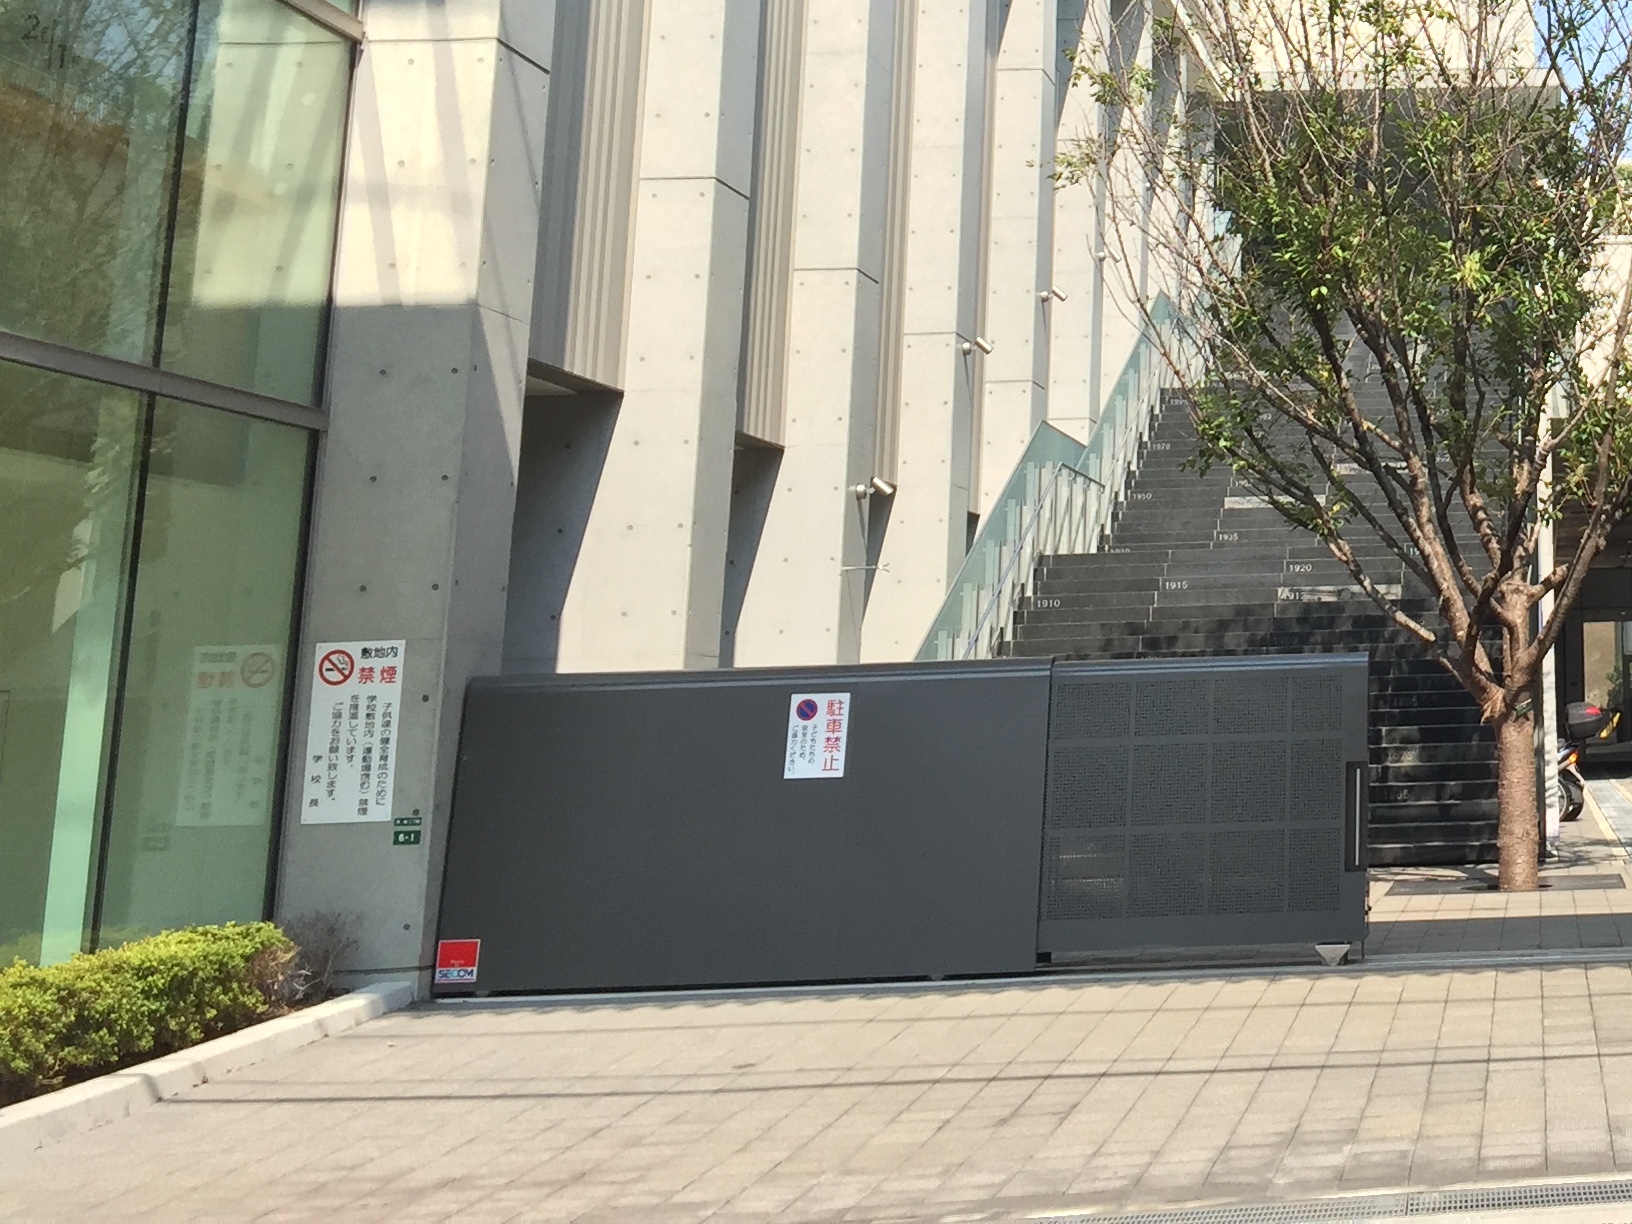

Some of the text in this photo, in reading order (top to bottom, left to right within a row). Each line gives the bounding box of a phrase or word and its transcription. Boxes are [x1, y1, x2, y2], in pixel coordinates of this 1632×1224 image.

[1152, 442, 1171, 450] 1970
[1289, 563, 1313, 573] 1920
[1165, 580, 1189, 590] 1915
[1037, 598, 1061, 608] 1910
[360, 646, 398, 660] 敷地内
[357, 665, 398, 685] 禁煙
[821, 699, 845, 772] 駐車禁止
[438, 968, 474, 979] SECOM
